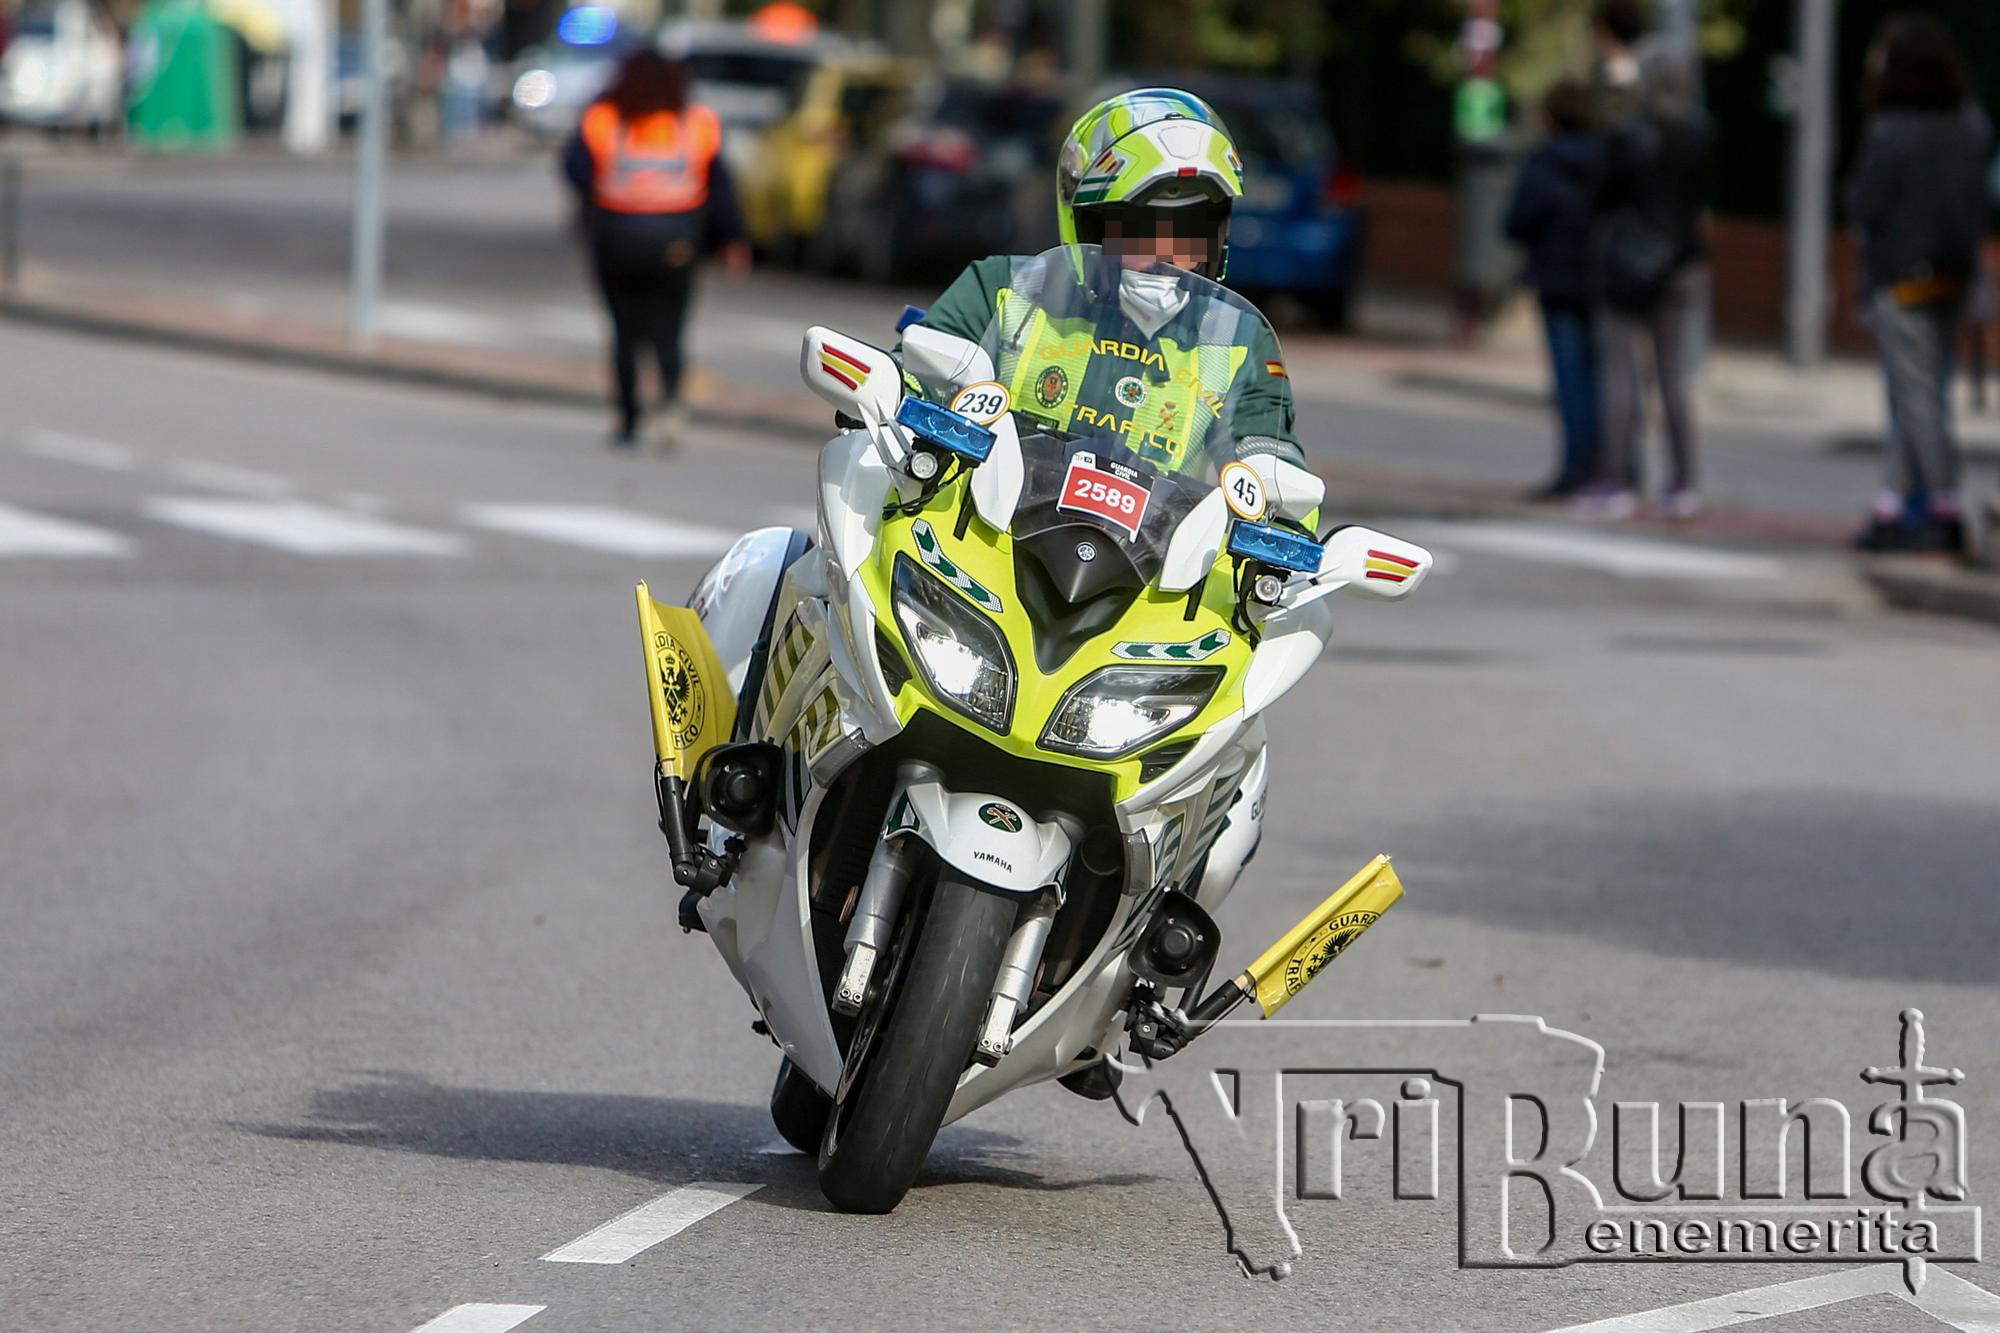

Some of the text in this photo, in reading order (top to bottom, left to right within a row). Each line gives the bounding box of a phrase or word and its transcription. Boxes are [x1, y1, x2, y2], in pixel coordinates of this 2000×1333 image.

[1039, 339, 1165, 372] GUARDIA
[957, 393, 1004, 415] 239
[1074, 479, 1136, 514] 2589
[1233, 477, 1257, 507] 45
[678, 649, 700, 687] CIVIL
[973, 850, 1013, 873] YAMAHA
